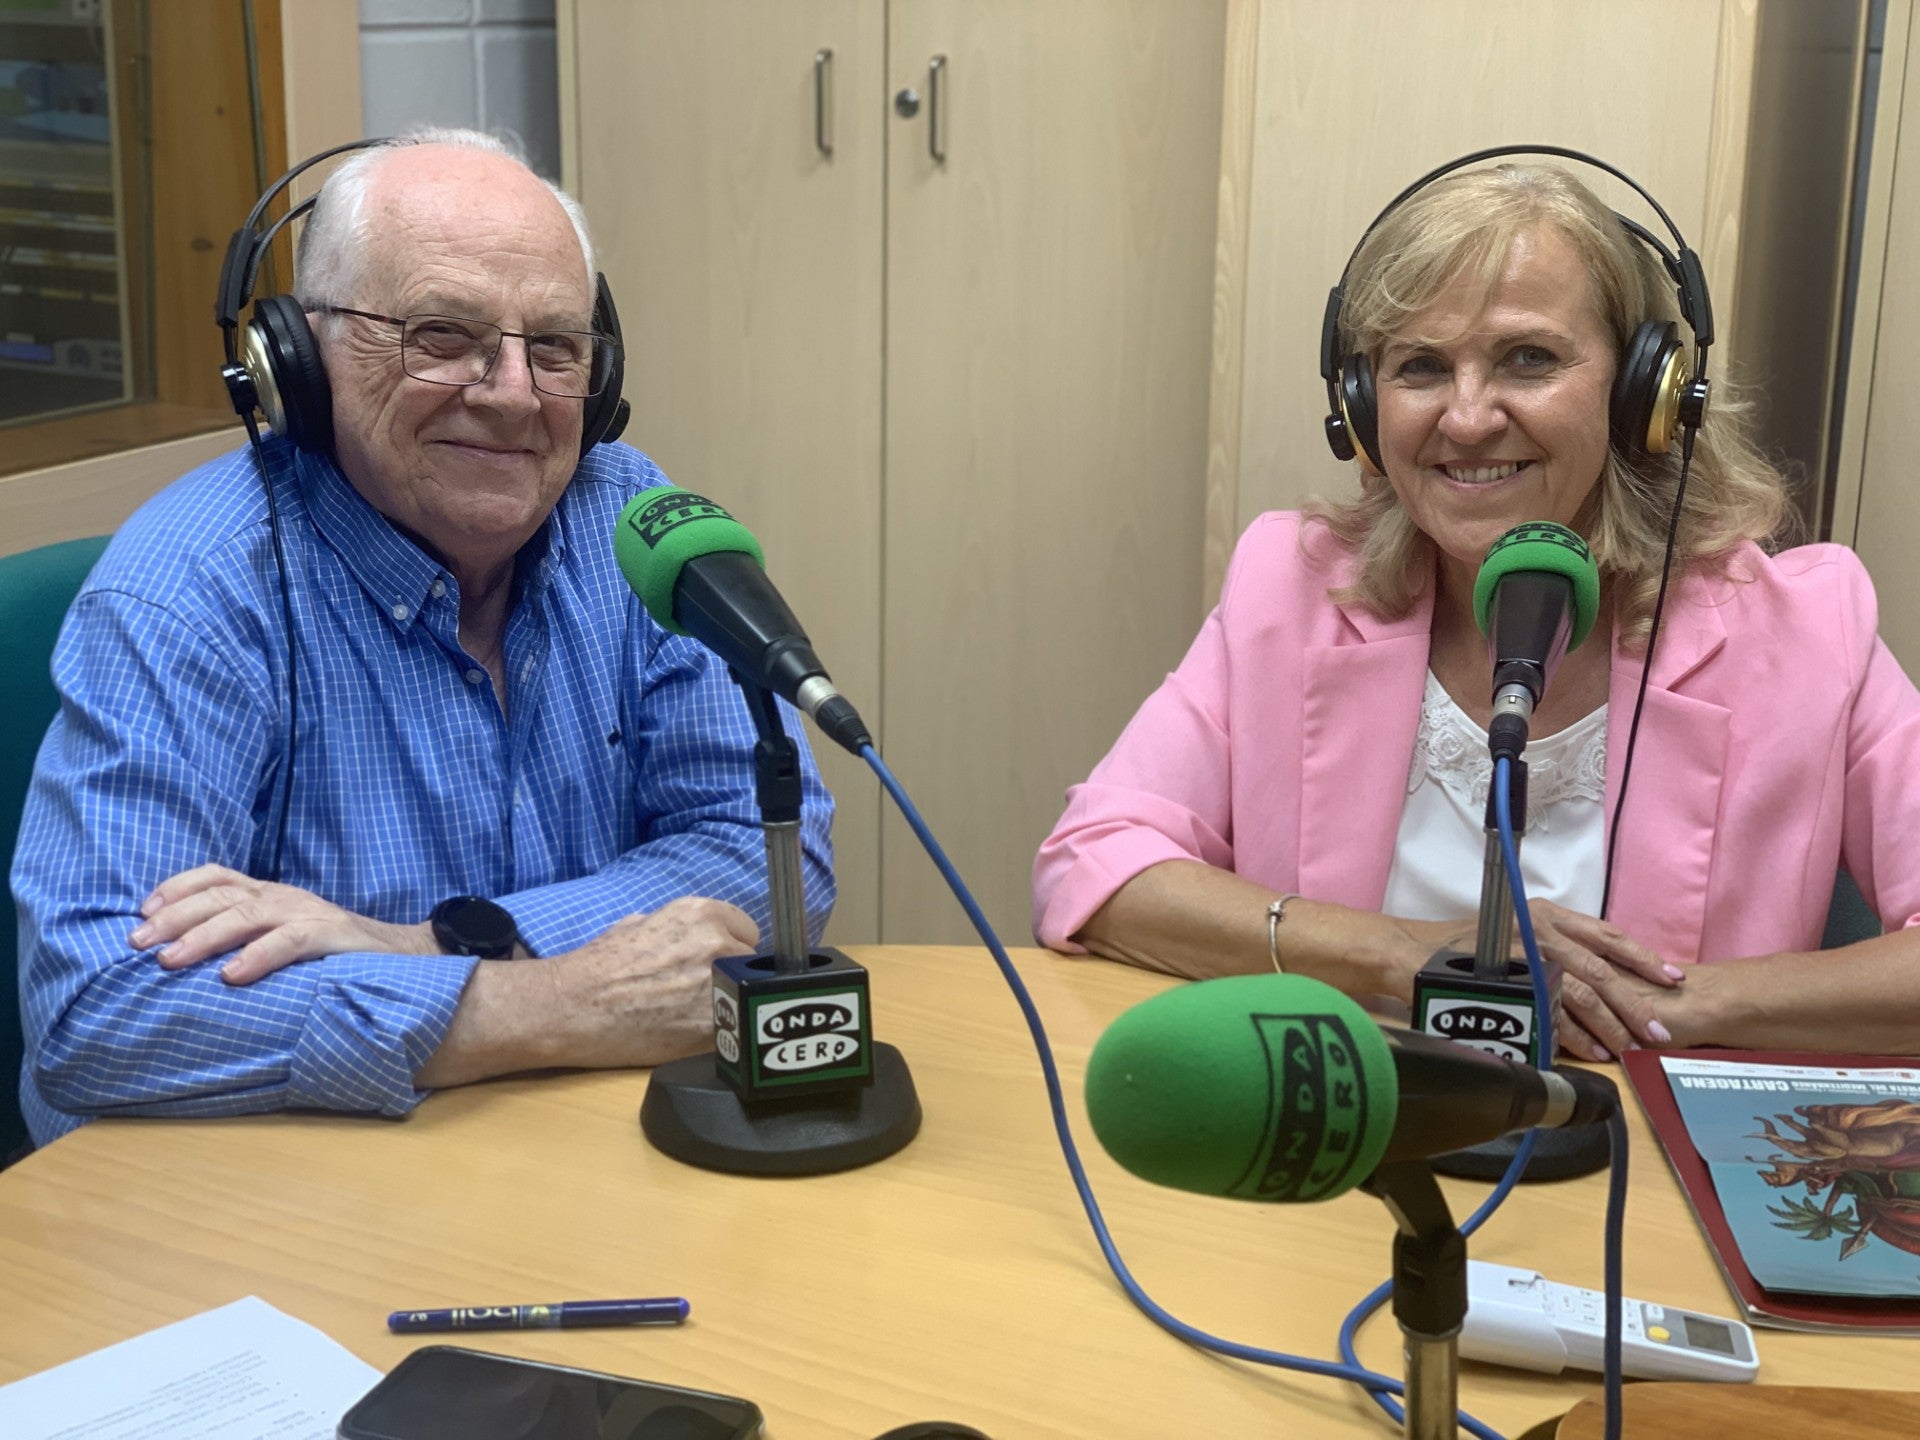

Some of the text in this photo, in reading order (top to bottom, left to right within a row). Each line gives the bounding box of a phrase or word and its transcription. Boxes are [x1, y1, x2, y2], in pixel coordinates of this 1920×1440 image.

[646, 497, 714, 517] OND
[769, 1009, 846, 1034] ONDA
[1439, 1012, 1516, 1035] ONDA
[777, 1041, 846, 1064] CERO
[1679, 1076, 1790, 1092] CARTAGENA
[1266, 1044, 1316, 1188] ONDA
[1309, 1042, 1354, 1185] CERO
[409, 1312, 428, 1322] 0.7
